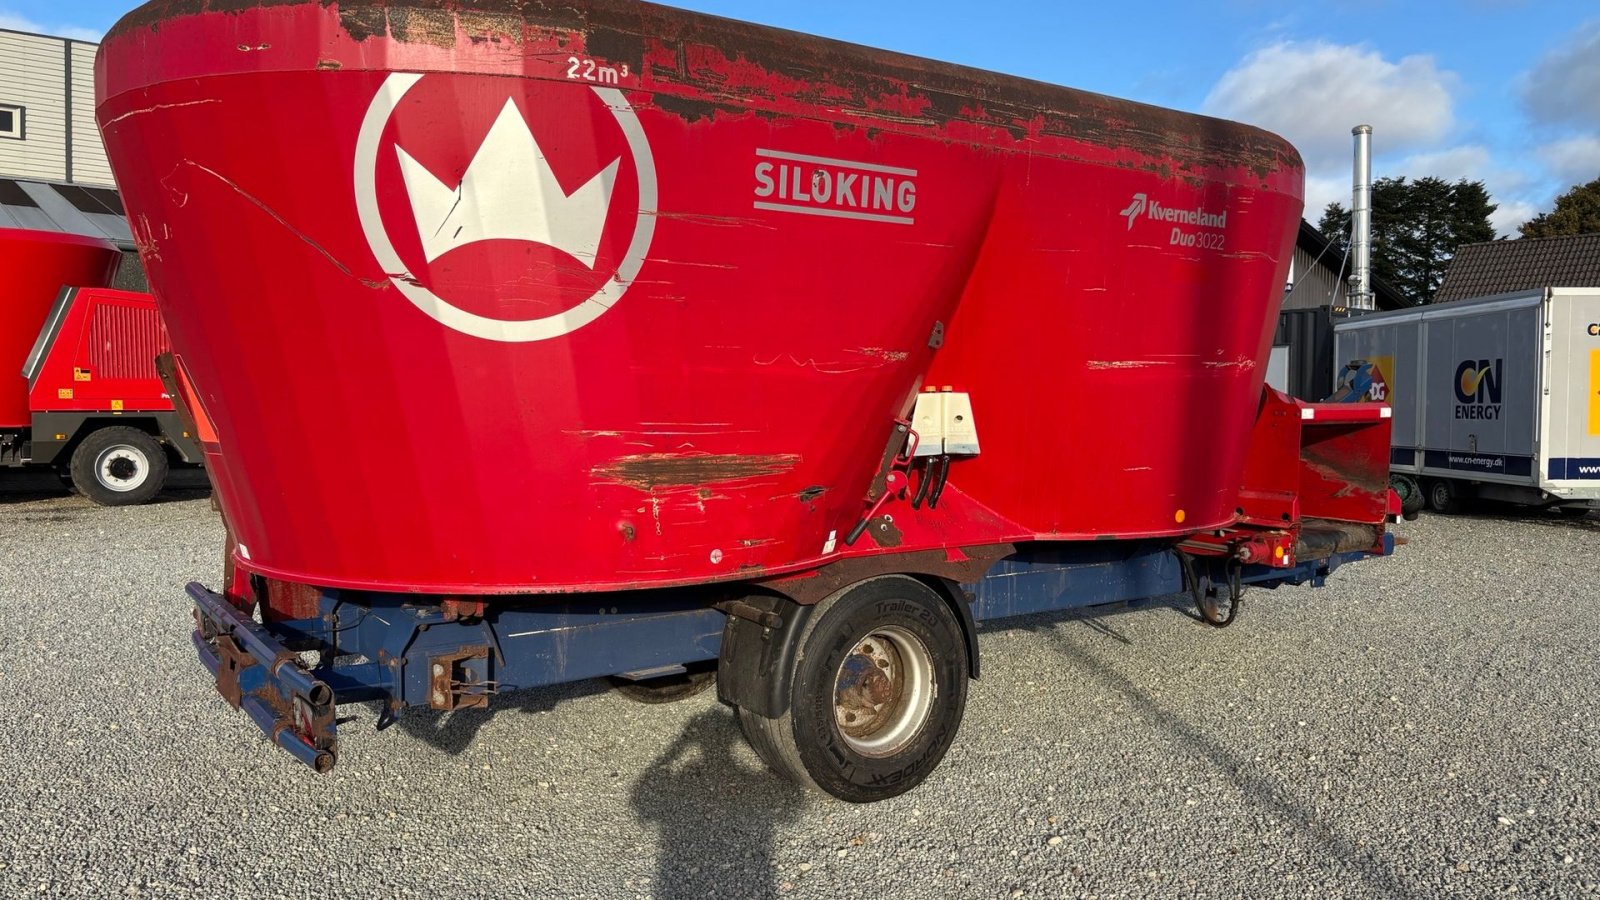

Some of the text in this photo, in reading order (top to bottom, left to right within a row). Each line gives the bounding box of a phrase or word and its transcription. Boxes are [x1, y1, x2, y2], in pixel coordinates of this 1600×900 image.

[754, 162, 916, 213] SILOKING
[1148, 200, 1227, 229] Kverneland
[1587, 323, 1600, 336] C
[1454, 359, 1503, 404] CN
[1455, 405, 1502, 420] ENERGY
[1448, 456, 1503, 468] www.cn-energy.dk
[875, 601, 919, 613] Trailer
